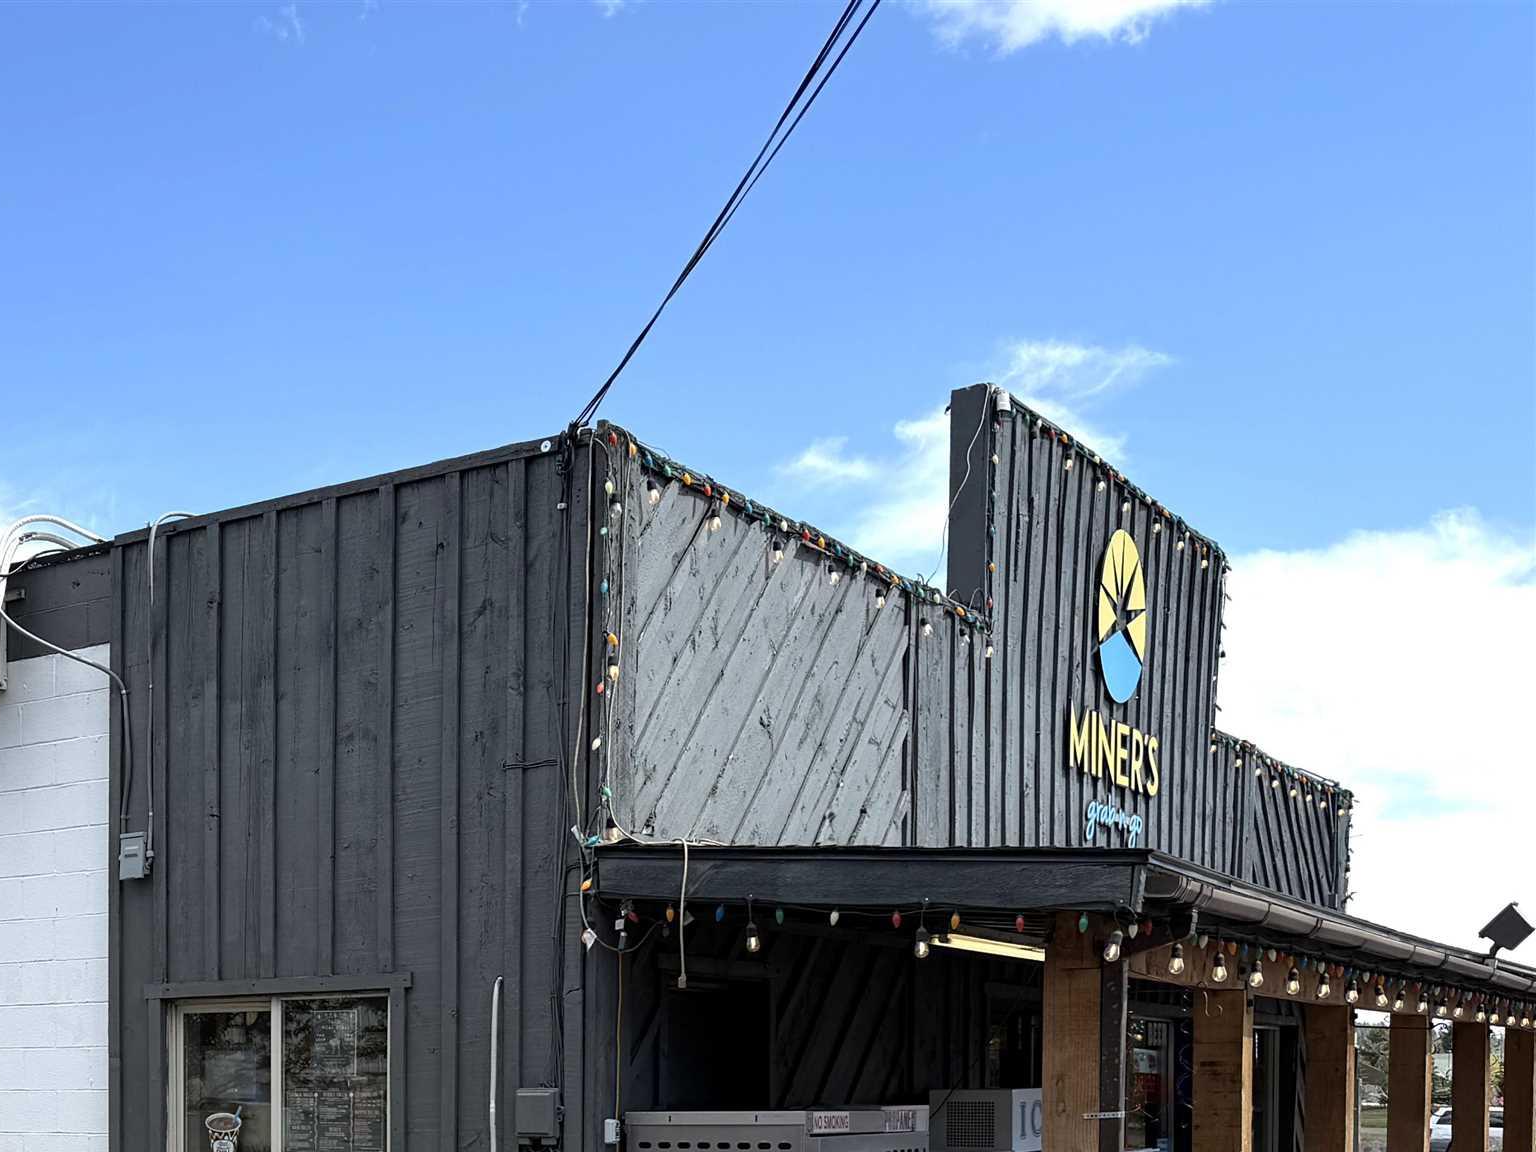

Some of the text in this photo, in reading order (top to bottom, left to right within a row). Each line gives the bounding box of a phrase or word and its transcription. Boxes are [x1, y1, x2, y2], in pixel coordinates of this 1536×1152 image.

[1069, 700, 1159, 797] MINER'S
[814, 1111, 848, 1130] NO SMOKING
